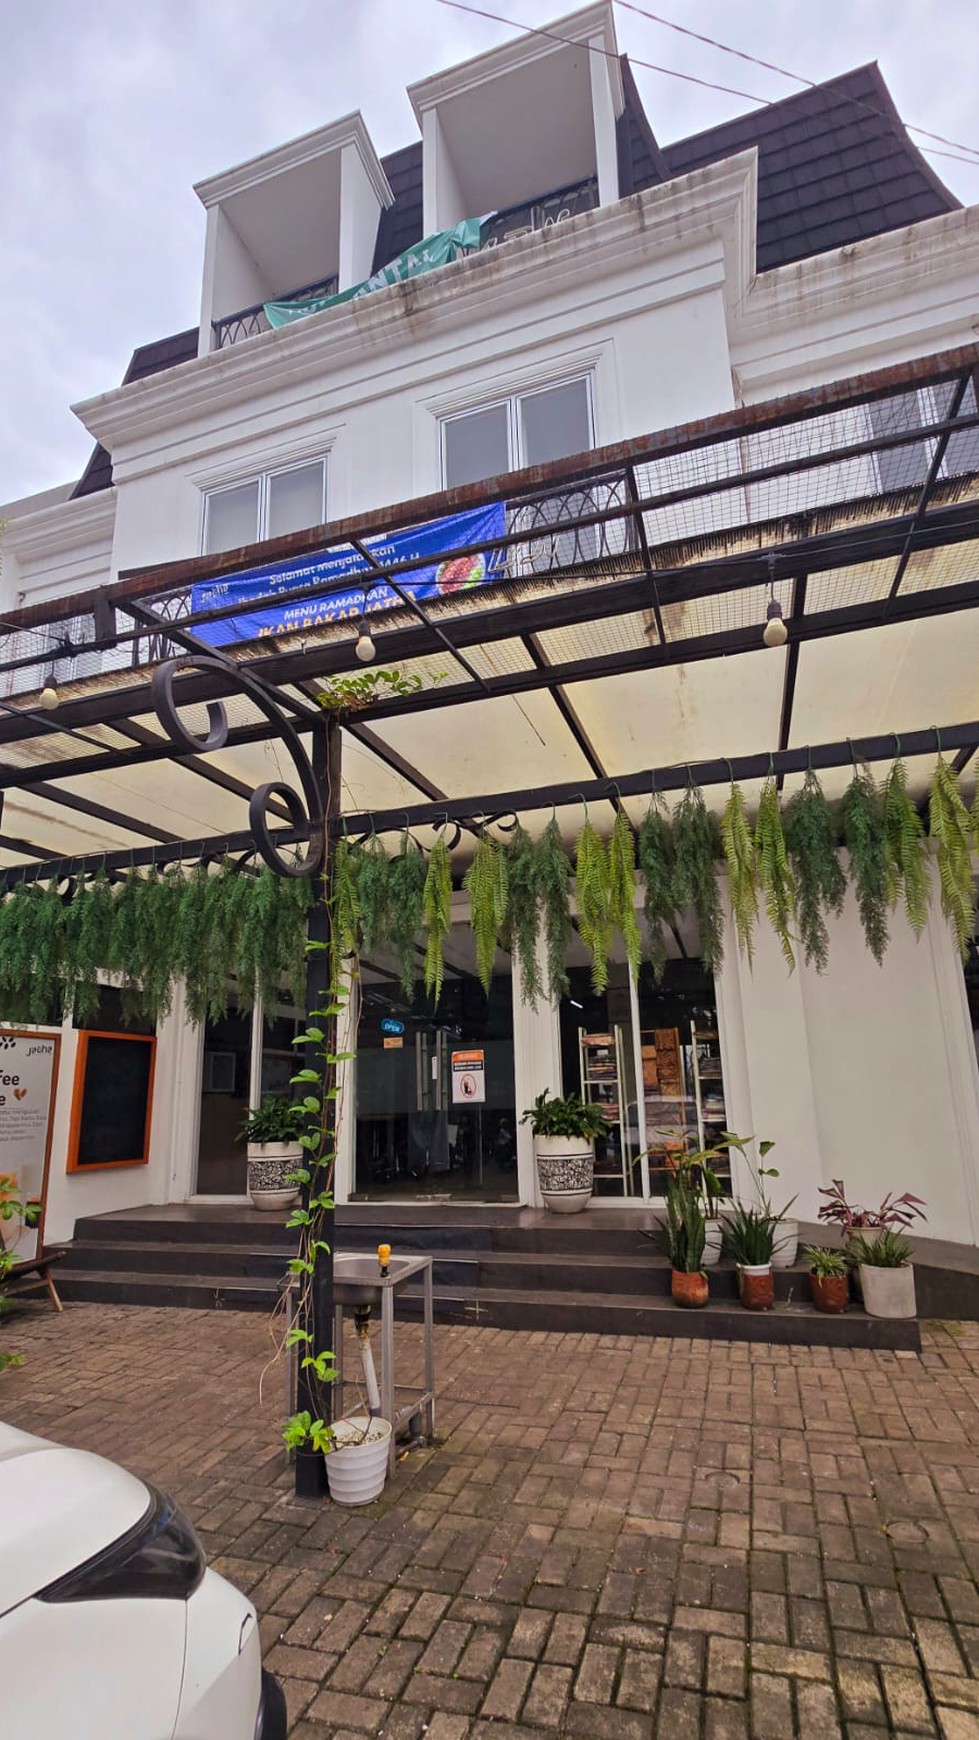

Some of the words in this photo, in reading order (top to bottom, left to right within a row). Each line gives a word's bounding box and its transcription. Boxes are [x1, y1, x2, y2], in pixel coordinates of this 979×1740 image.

[269, 566, 315, 585] Selamat
[317, 544, 396, 571] Menjalakan
[284, 604, 318, 620] MENU
